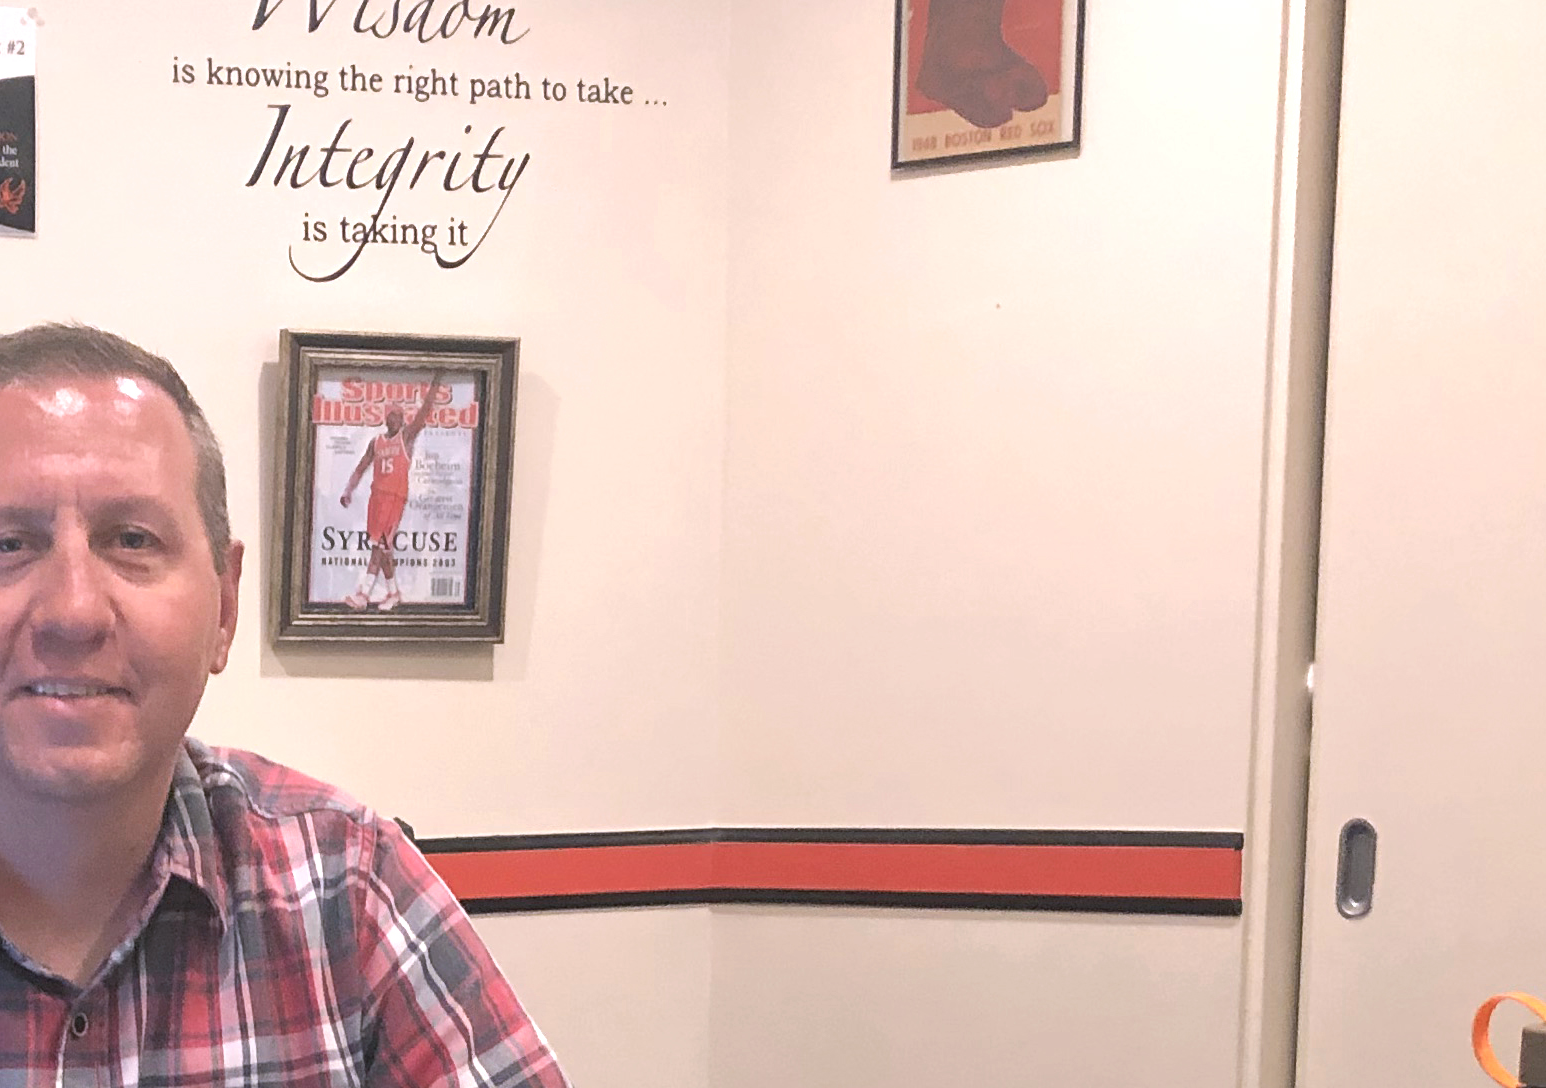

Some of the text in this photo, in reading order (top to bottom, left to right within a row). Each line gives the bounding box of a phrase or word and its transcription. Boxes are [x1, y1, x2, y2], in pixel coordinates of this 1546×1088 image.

[7, 40, 25, 55] #2
[172, 57, 196, 85] is
[206, 58, 329, 97] knowing
[339, 64, 383, 93] the
[393, 65, 459, 102] right
[469, 72, 531, 104] path
[542, 77, 567, 102] to
[577, 78, 634, 105] take
[945, 129, 992, 148] BOSTON
[1000, 125, 1022, 140] RED
[1030, 120, 1054, 137] SOX
[2, 144, 18, 155] the
[245, 104, 530, 282] Integrity
[302, 213, 469, 254] is taking it
[312, 394, 479, 428] Illusated
[381, 458, 394, 473] 15
[321, 526, 458, 552] SYRACUSE
[321, 557, 369, 567] NATIONAL
